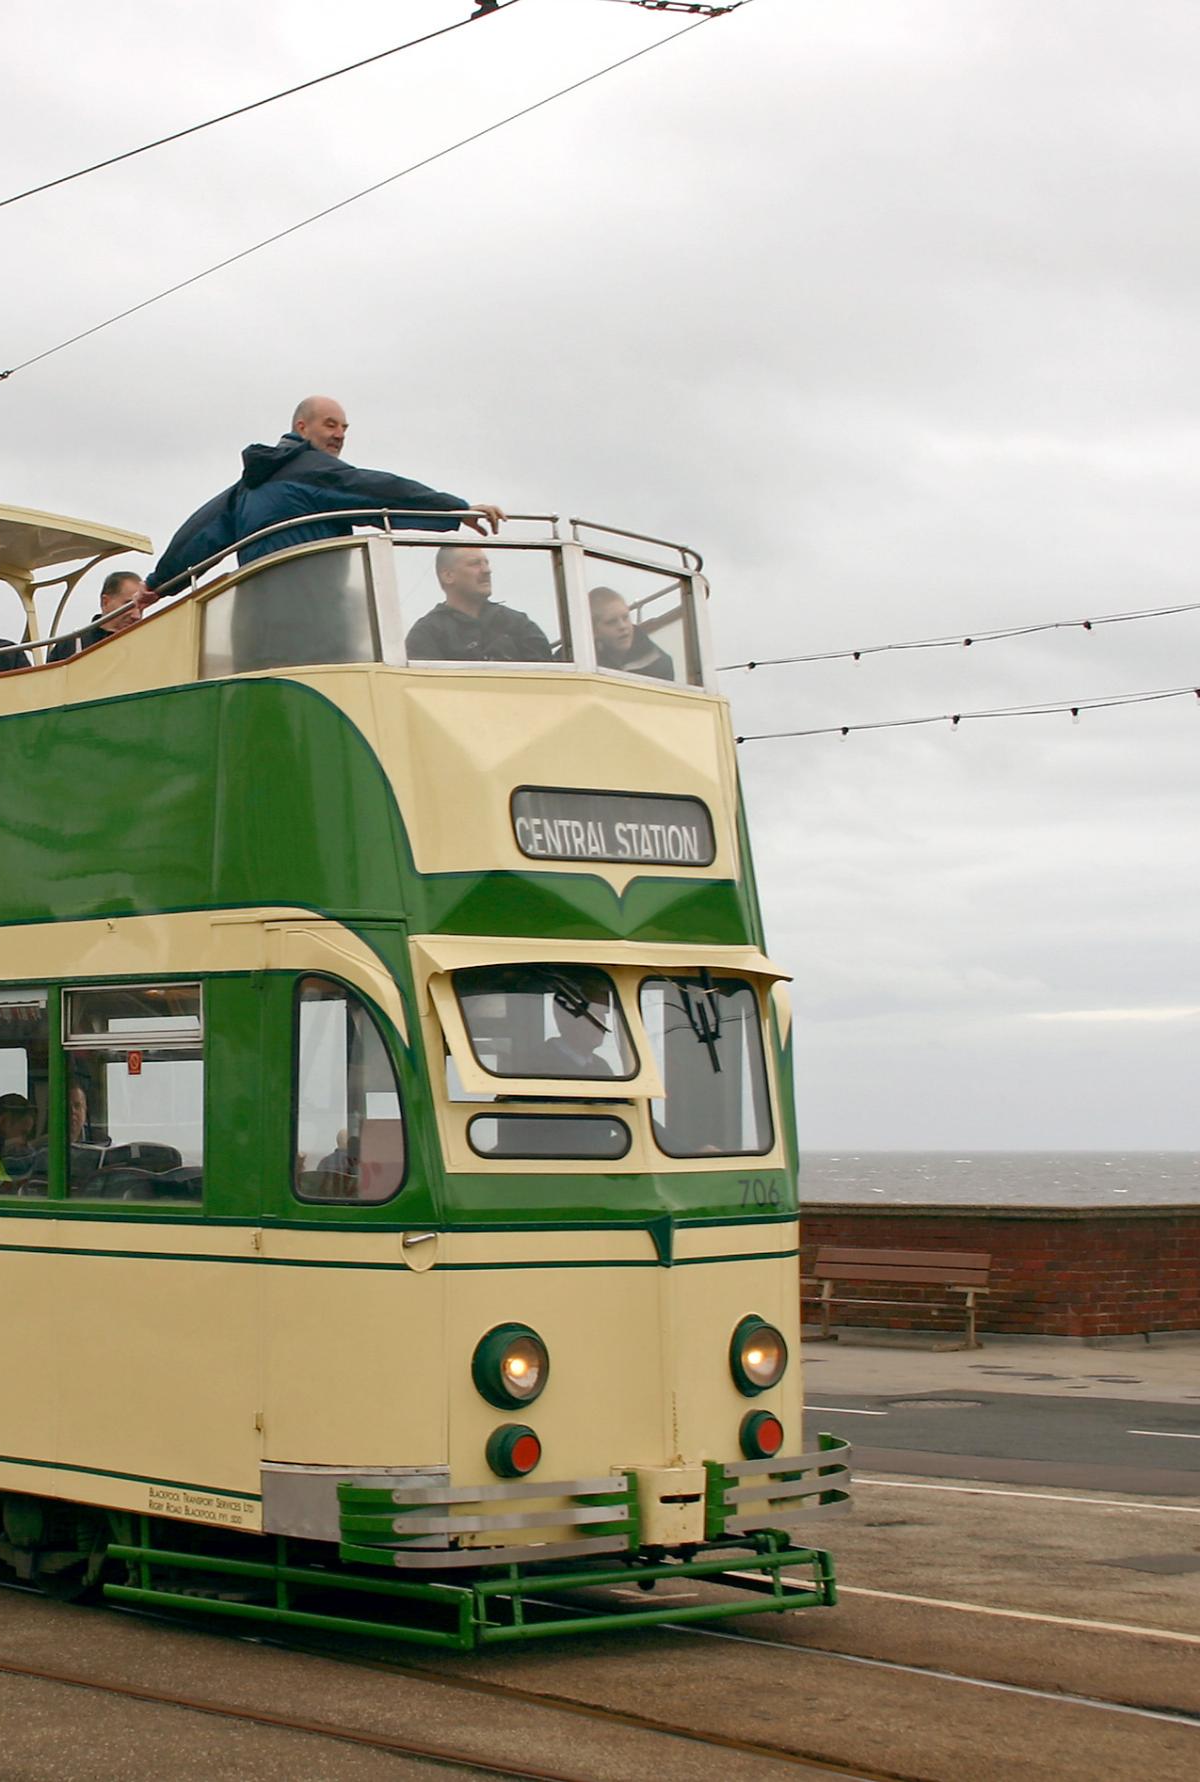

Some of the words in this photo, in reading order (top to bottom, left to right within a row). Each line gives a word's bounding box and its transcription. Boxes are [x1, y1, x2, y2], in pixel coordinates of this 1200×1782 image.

[515, 816, 608, 856] CENTRAL
[615, 822, 699, 860] STATION
[738, 1178, 780, 1208] 706
